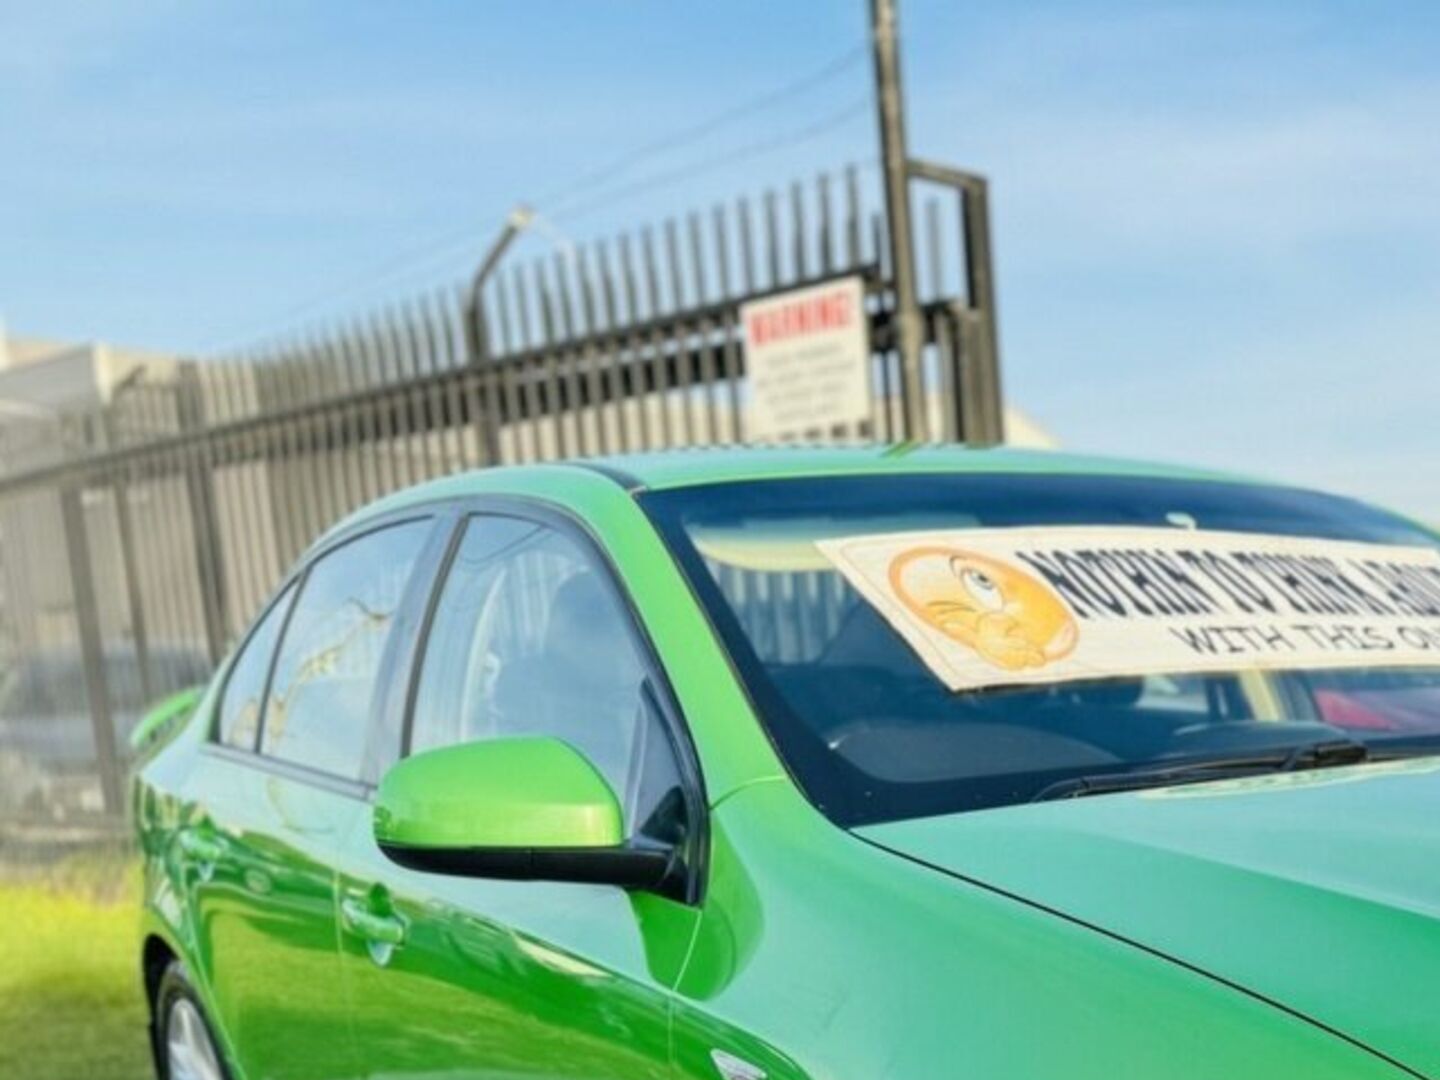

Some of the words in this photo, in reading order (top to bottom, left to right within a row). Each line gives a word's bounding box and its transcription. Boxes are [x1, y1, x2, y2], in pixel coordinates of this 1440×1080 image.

[1175, 549, 1277, 614] TO
[1230, 551, 1398, 616] THINK
[1168, 624, 1297, 653] WITH
[1290, 624, 1396, 650] THIS
